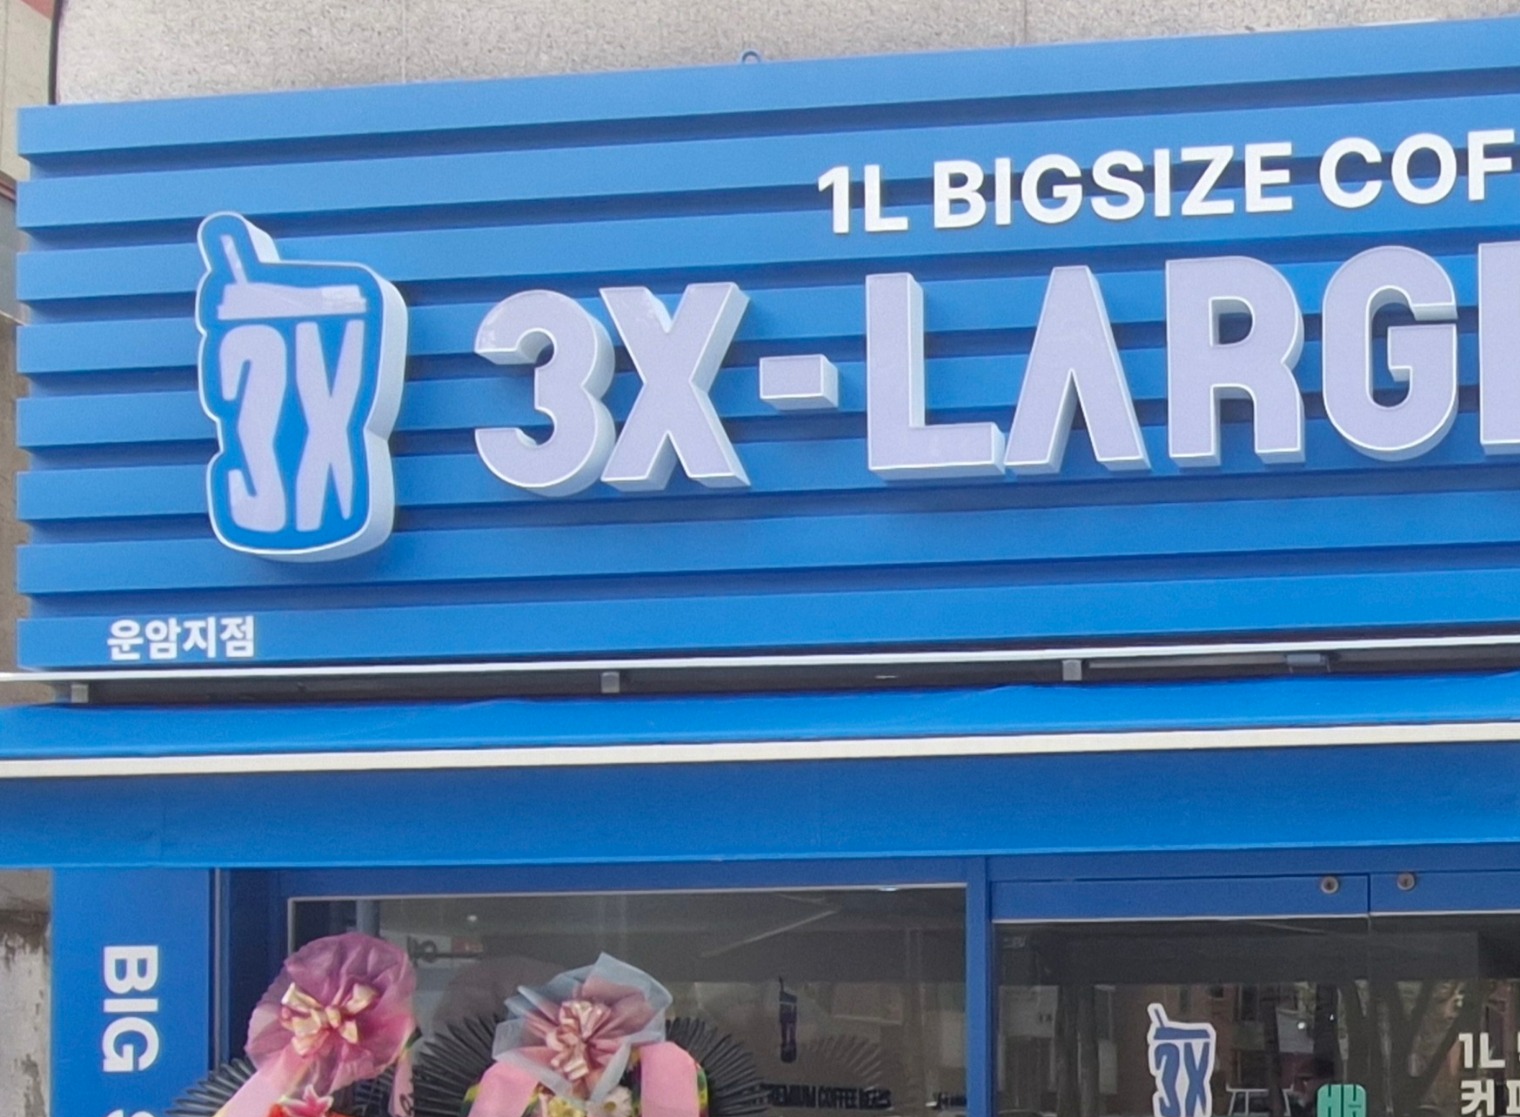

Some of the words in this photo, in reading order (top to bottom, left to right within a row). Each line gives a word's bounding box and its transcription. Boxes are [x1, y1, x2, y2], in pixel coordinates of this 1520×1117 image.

[815, 164, 909, 235] 1L
[931, 142, 1294, 230] BIGSIZE
[106, 614, 256, 660] 운암지점
[102, 944, 159, 1072] BIG
[1458, 1032, 1506, 1069] 1L
